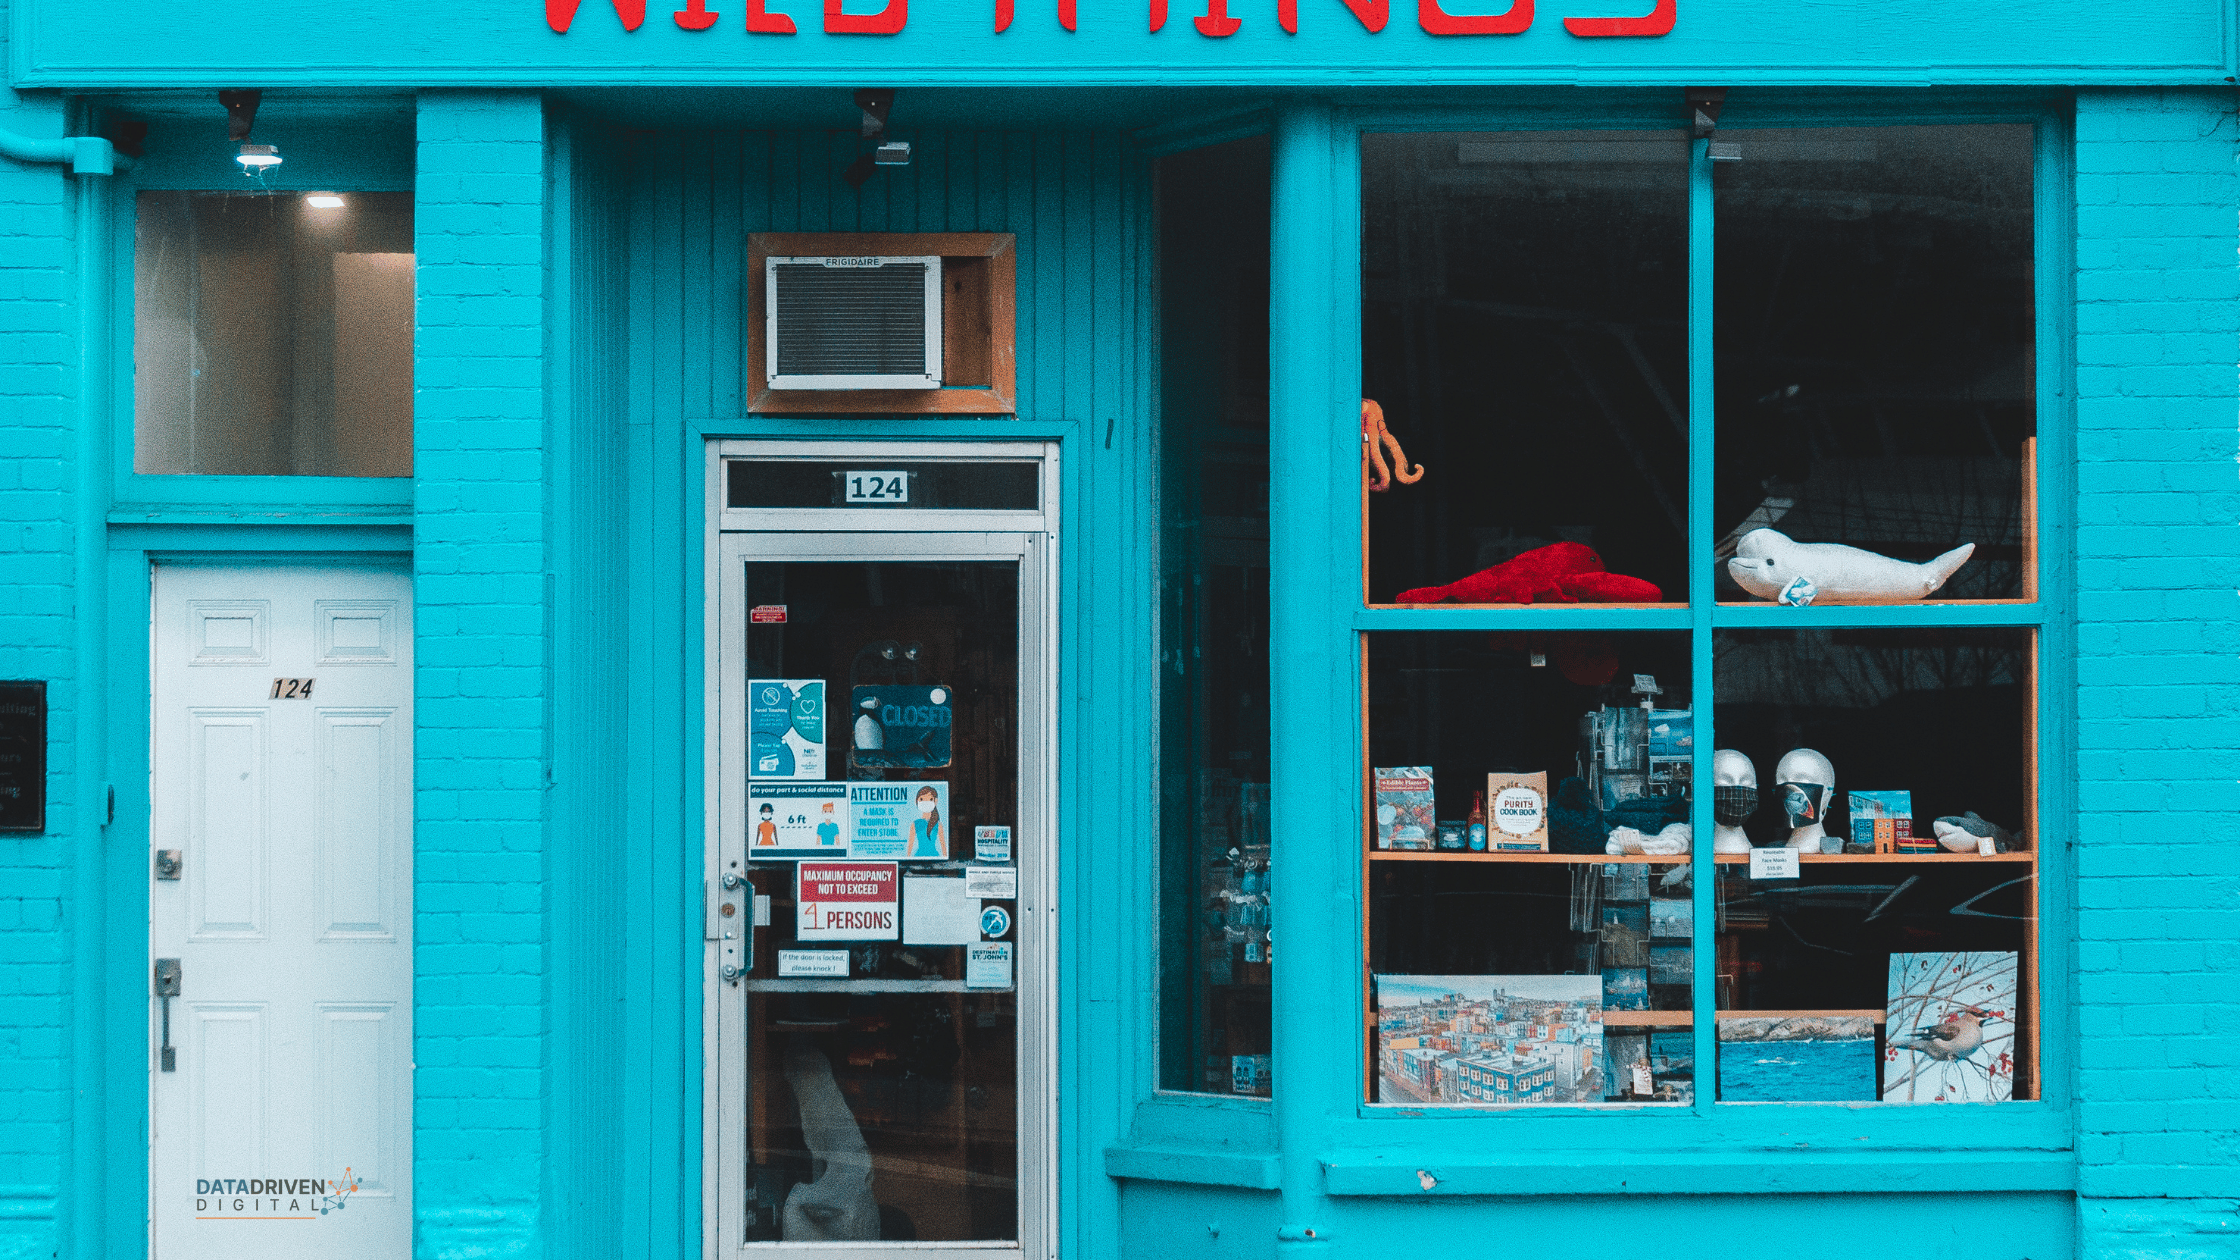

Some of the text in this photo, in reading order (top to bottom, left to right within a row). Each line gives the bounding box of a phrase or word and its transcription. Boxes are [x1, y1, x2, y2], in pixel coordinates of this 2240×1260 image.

[826, 258, 880, 266] FRIGIDAIRE
[852, 477, 903, 498] 124
[275, 679, 313, 699] 124
[881, 704, 952, 727] CLOSED
[851, 787, 908, 801] ATTENTION
[1504, 800, 1534, 808] PURITY
[788, 814, 807, 824] 6 ft
[859, 818, 890, 826] REQUIRED
[803, 870, 893, 882] MAXIMUM OCCUPANCY
[818, 883, 879, 895] NOT TO EXCEED
[827, 911, 893, 930] PERSONS
